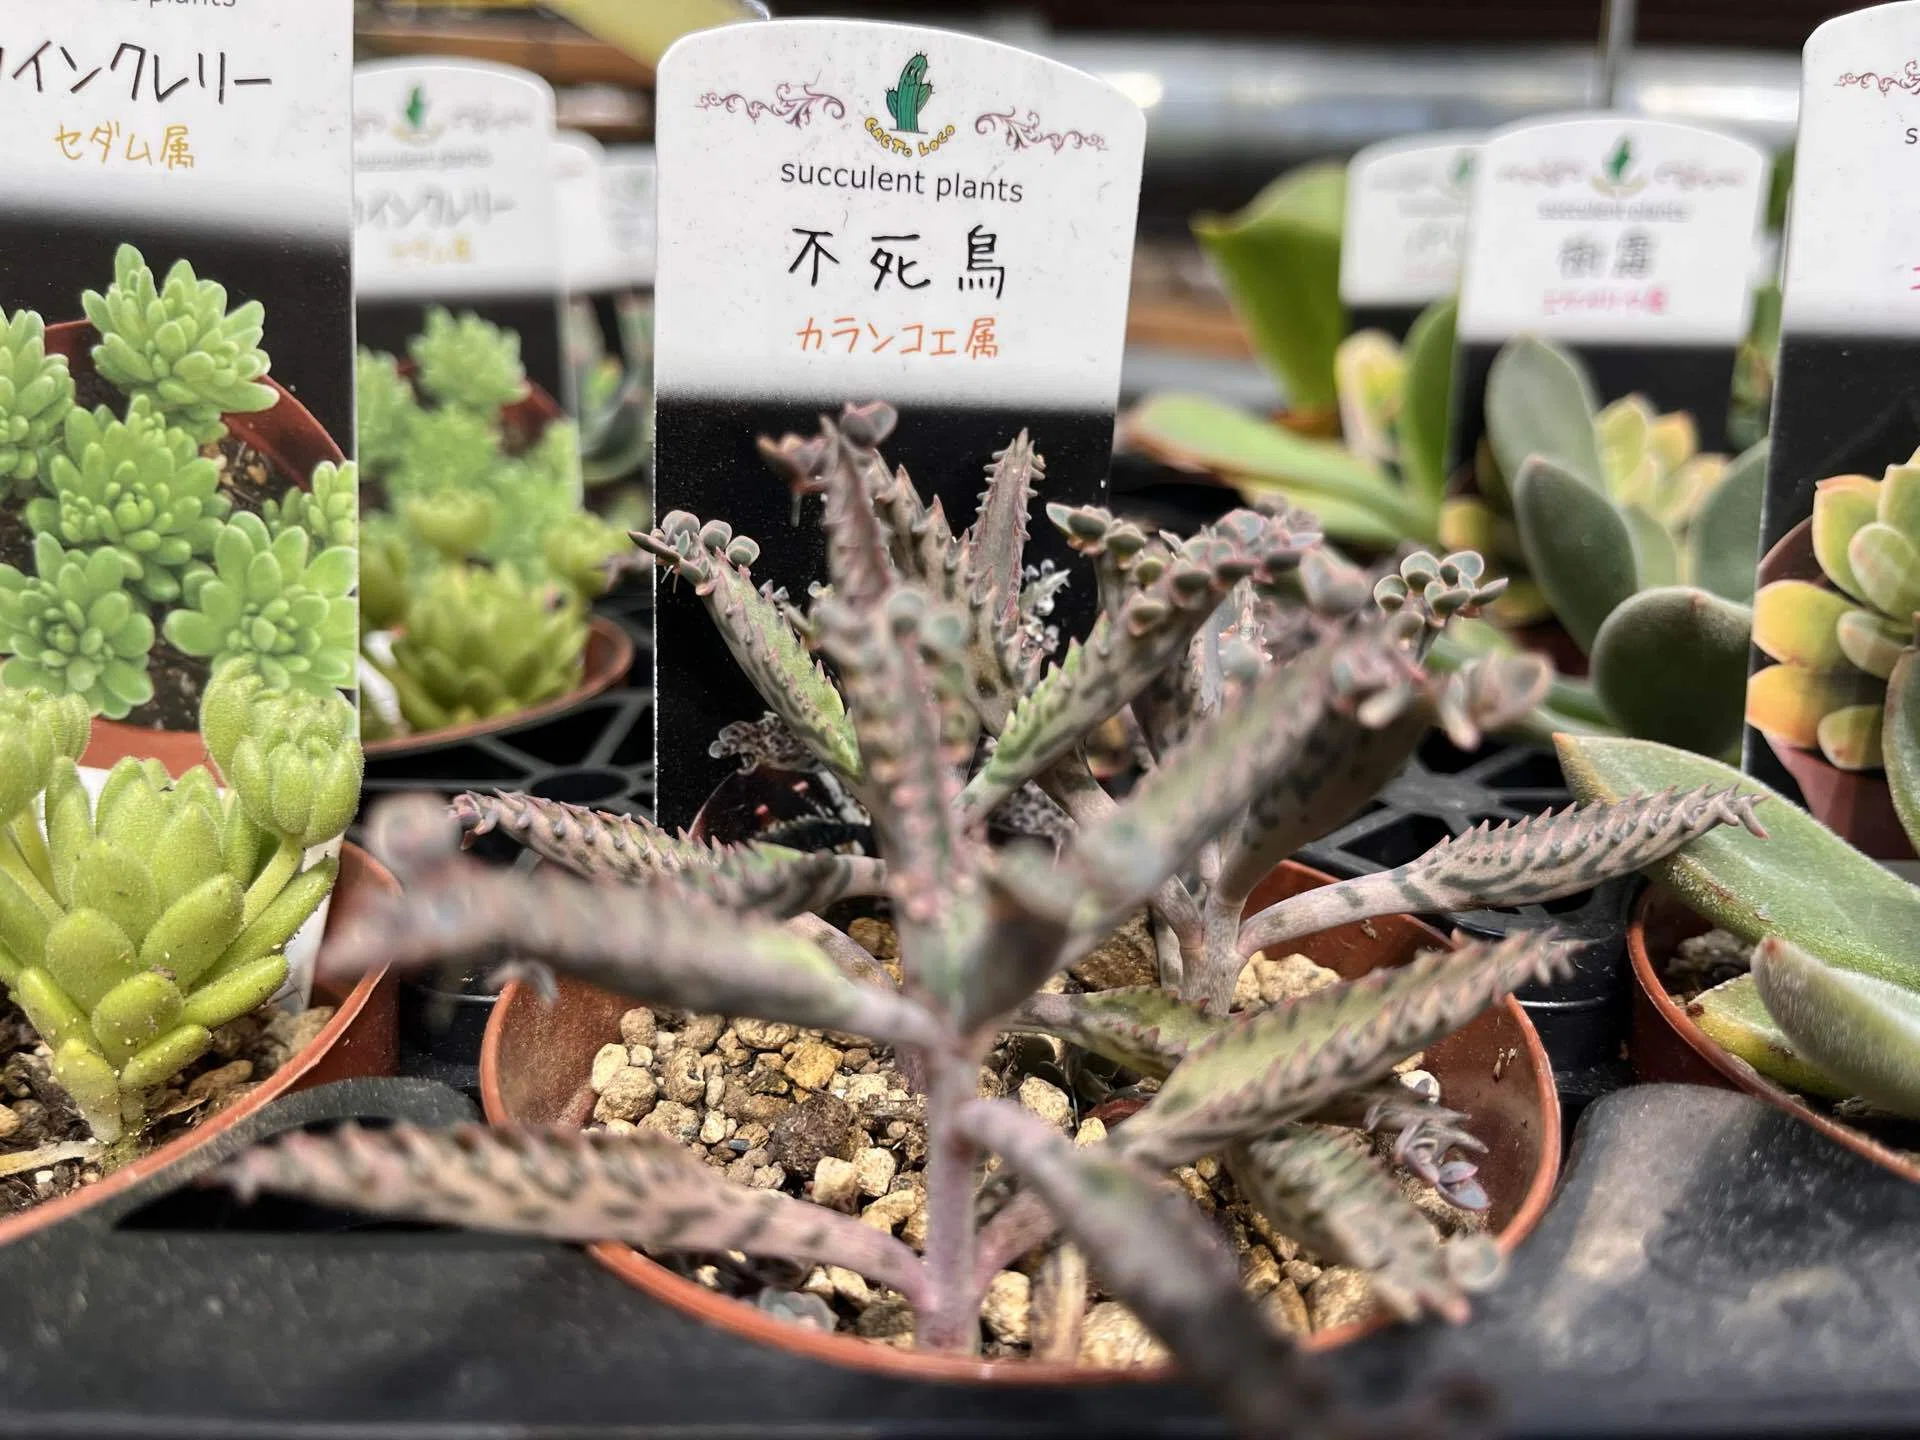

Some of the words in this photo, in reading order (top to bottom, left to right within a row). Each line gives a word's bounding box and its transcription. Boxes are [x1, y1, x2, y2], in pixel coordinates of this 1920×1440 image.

[0, 40, 272, 104] インクレリー
[55, 119, 195, 170] セダム属
[864, 117, 912, 158] CACTO
[918, 125, 955, 157] LOCO
[781, 162, 926, 194] succulent
[936, 172, 1024, 203] plants
[788, 224, 1004, 300] 不死鳥
[796, 317, 1000, 360] カランコエ属
